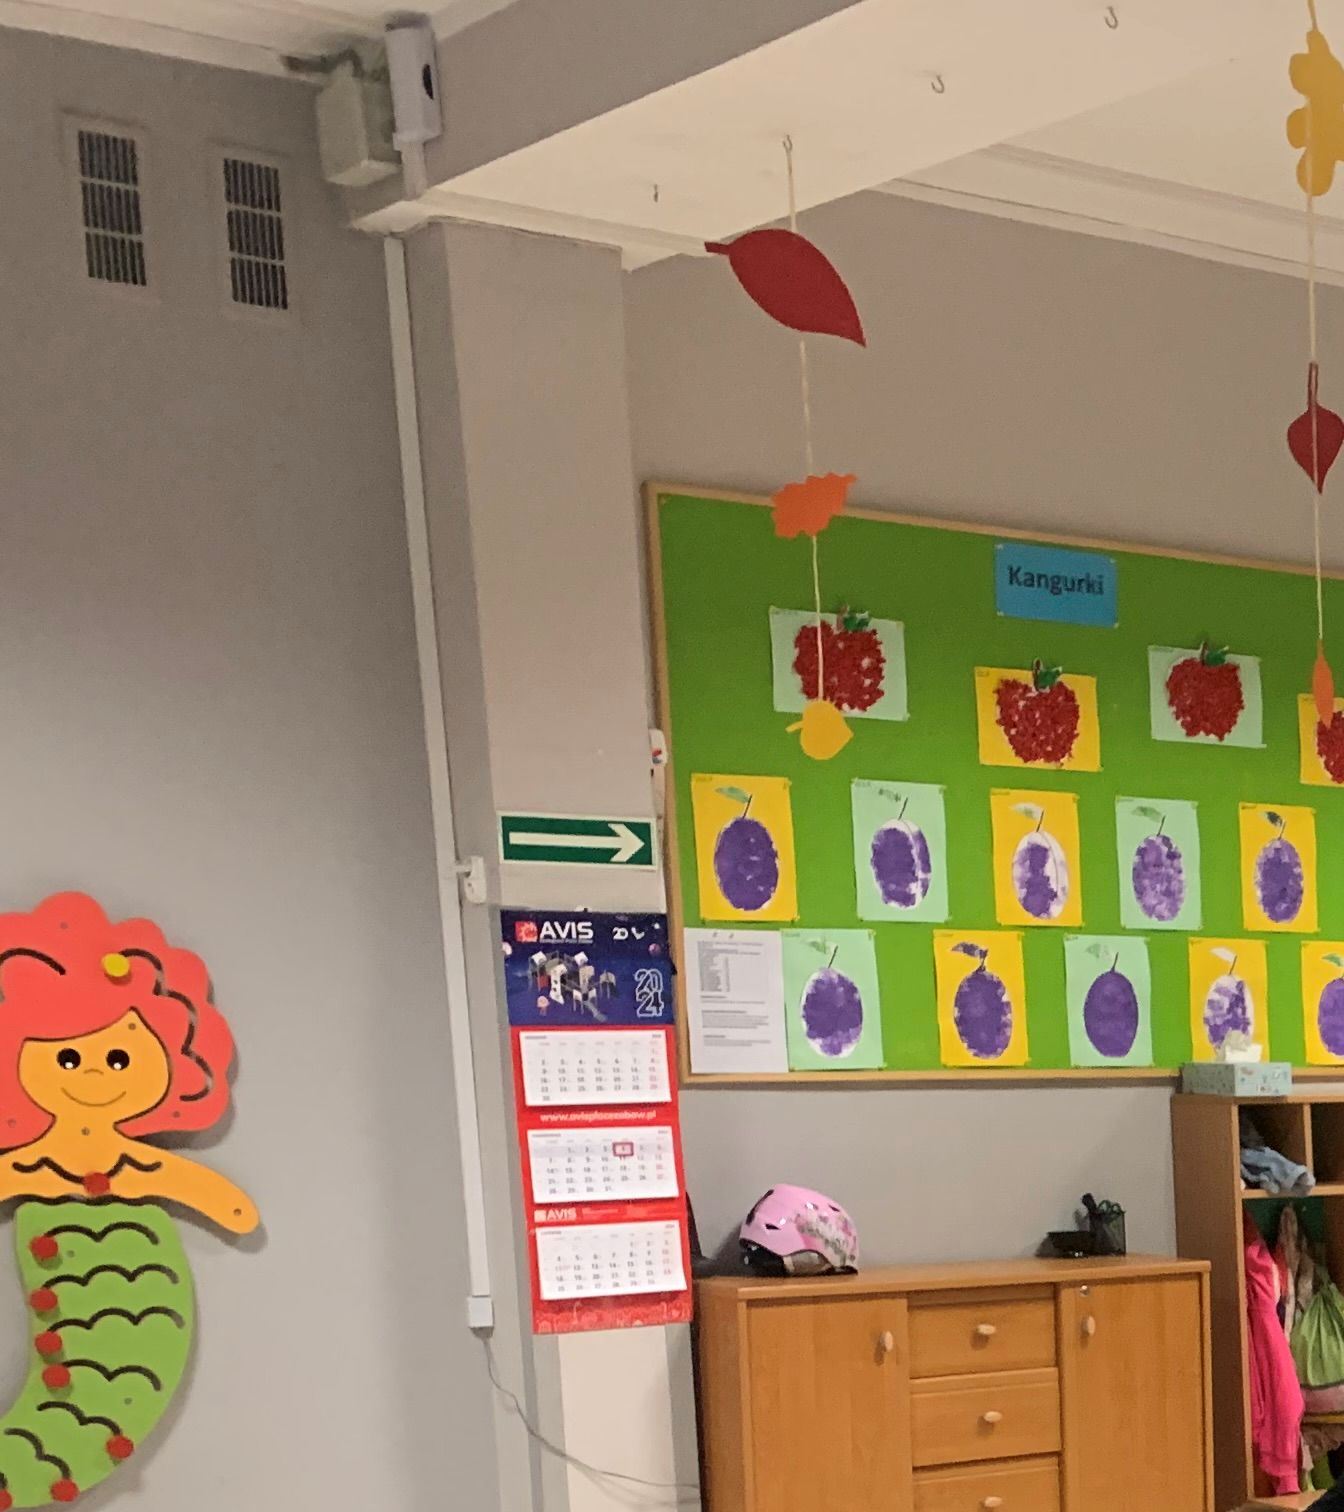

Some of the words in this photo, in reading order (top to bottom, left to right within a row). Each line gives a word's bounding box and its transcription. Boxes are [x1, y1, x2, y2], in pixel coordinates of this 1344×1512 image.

[1008, 564, 1104, 596] Kangurki
[539, 921, 594, 939] AVIS
[546, 1208, 577, 1221] AVIS
